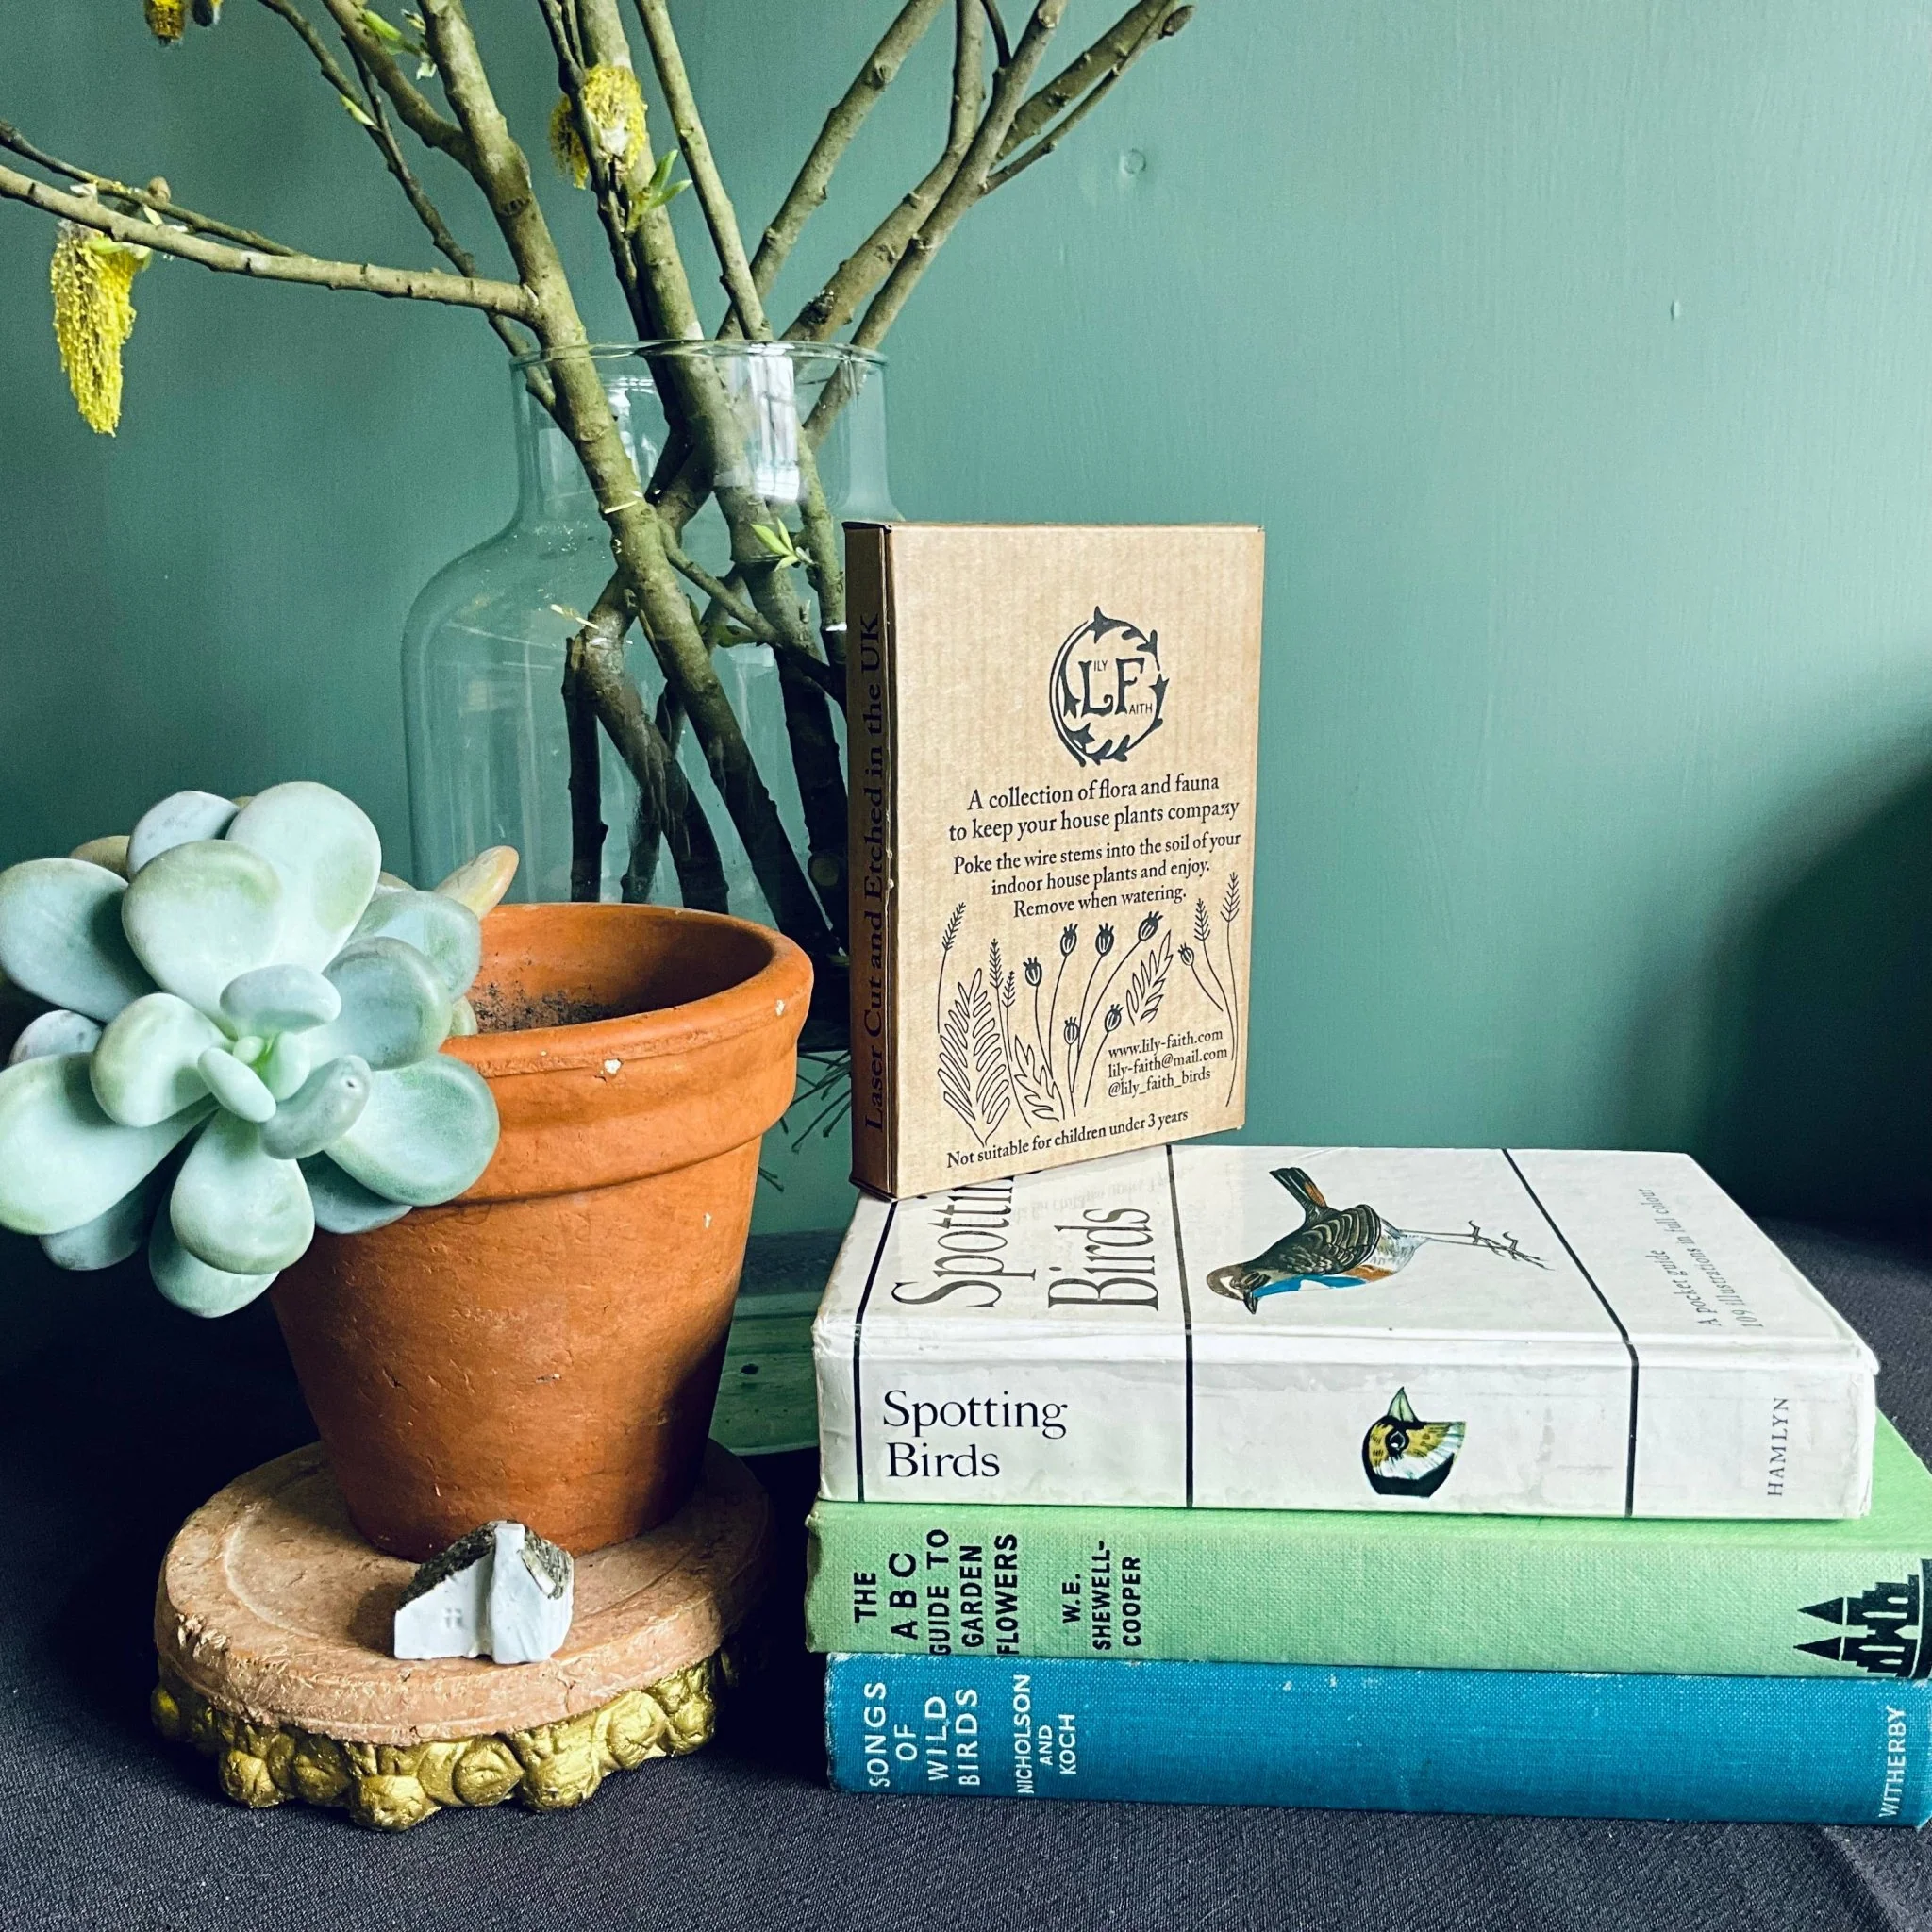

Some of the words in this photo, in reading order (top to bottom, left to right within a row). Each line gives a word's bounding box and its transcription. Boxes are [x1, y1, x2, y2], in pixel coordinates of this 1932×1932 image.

[860, 614, 879, 673] UK
[863, 683, 882, 736] the
[865, 746, 883, 778] in
[967, 789, 984, 810] A
[989, 785, 1073, 808] collection
[1078, 779, 1098, 800] of
[1099, 778, 1137, 799] flora
[1141, 774, 1171, 795] and
[1175, 773, 1219, 792] fauna
[863, 788, 884, 899] Etched
[949, 825, 967, 841] to
[972, 818, 1013, 842] keep
[1017, 818, 1057, 841] your
[1060, 809, 1109, 830] house
[1114, 805, 1163, 832] plants
[953, 854, 991, 874] Poke
[996, 852, 1021, 870] the
[1024, 849, 1057, 867] wire
[1060, 849, 1102, 863] stems
[1106, 842, 1135, 858] into
[1140, 838, 1161, 855] the
[1165, 833, 1189, 852] soil
[1193, 831, 1209, 849] of
[1209, 834, 1241, 853] your
[991, 875, 1043, 895] indoor
[1046, 872, 1090, 889] house
[1093, 866, 1137, 891] plants
[1141, 859, 1166, 878] and
[1171, 858, 1209, 879] enjoy.
[1013, 900, 1074, 918] Remove
[1078, 891, 1117, 909] when
[1121, 885, 1186, 905] watering.
[864, 909, 882, 970] and
[863, 977, 883, 1038] Cut
[1108, 1028, 1223, 1058] www.lily-faith.com
[1108, 1047, 1227, 1078] lily-faith@mail.com
[864, 1046, 884, 1132] Laser
[1108, 1068, 1211, 1098] @lily_faith_birds
[947, 1151, 974, 1168] Not
[978, 1139, 1029, 1161] suitable
[1032, 1135, 1052, 1151] for
[1055, 1126, 1107, 1146] children
[1109, 1117, 1145, 1135] under
[1148, 1113, 1155, 1127] 3
[1158, 1111, 1188, 1130] years
[1638, 1188, 1670, 1215] colour
[891, 1167, 1036, 1307] Spotti
[1048, 1208, 1158, 1312] Birds
[1677, 1236, 1694, 1244] in
[1645, 1249, 1687, 1280] guide
[1686, 1247, 1745, 1306] illustrations
[1674, 1277, 1718, 1313] pocket
[1698, 1318, 1722, 1328] A
[883, 1390, 1068, 1439] Spotting
[887, 1442, 1000, 1477] Birds
[1767, 1397, 1789, 1496] HAMLYN
[926, 1529, 949, 1569] TO
[854, 1572, 876, 1623] THE
[927, 1585, 951, 1655] GUIDE
[960, 1545, 984, 1647] GARDEN
[994, 1534, 1019, 1654] FLOWERS
[1062, 1573, 1081, 1624] W.E.
[1091, 1541, 1111, 1650] SHEWELL-
[1122, 1557, 1141, 1646] COOPER
[864, 1682, 890, 1787] SONGS
[894, 1724, 917, 1761] OF
[925, 1696, 949, 1780] WILD
[956, 1689, 980, 1785] BIRDS
[1013, 1674, 1034, 1794] NICHOLSON
[1038, 1724, 1053, 1765] AND
[1058, 1714, 1076, 1774] KOCH
[1878, 1705, 1906, 1818] WITHERBY
